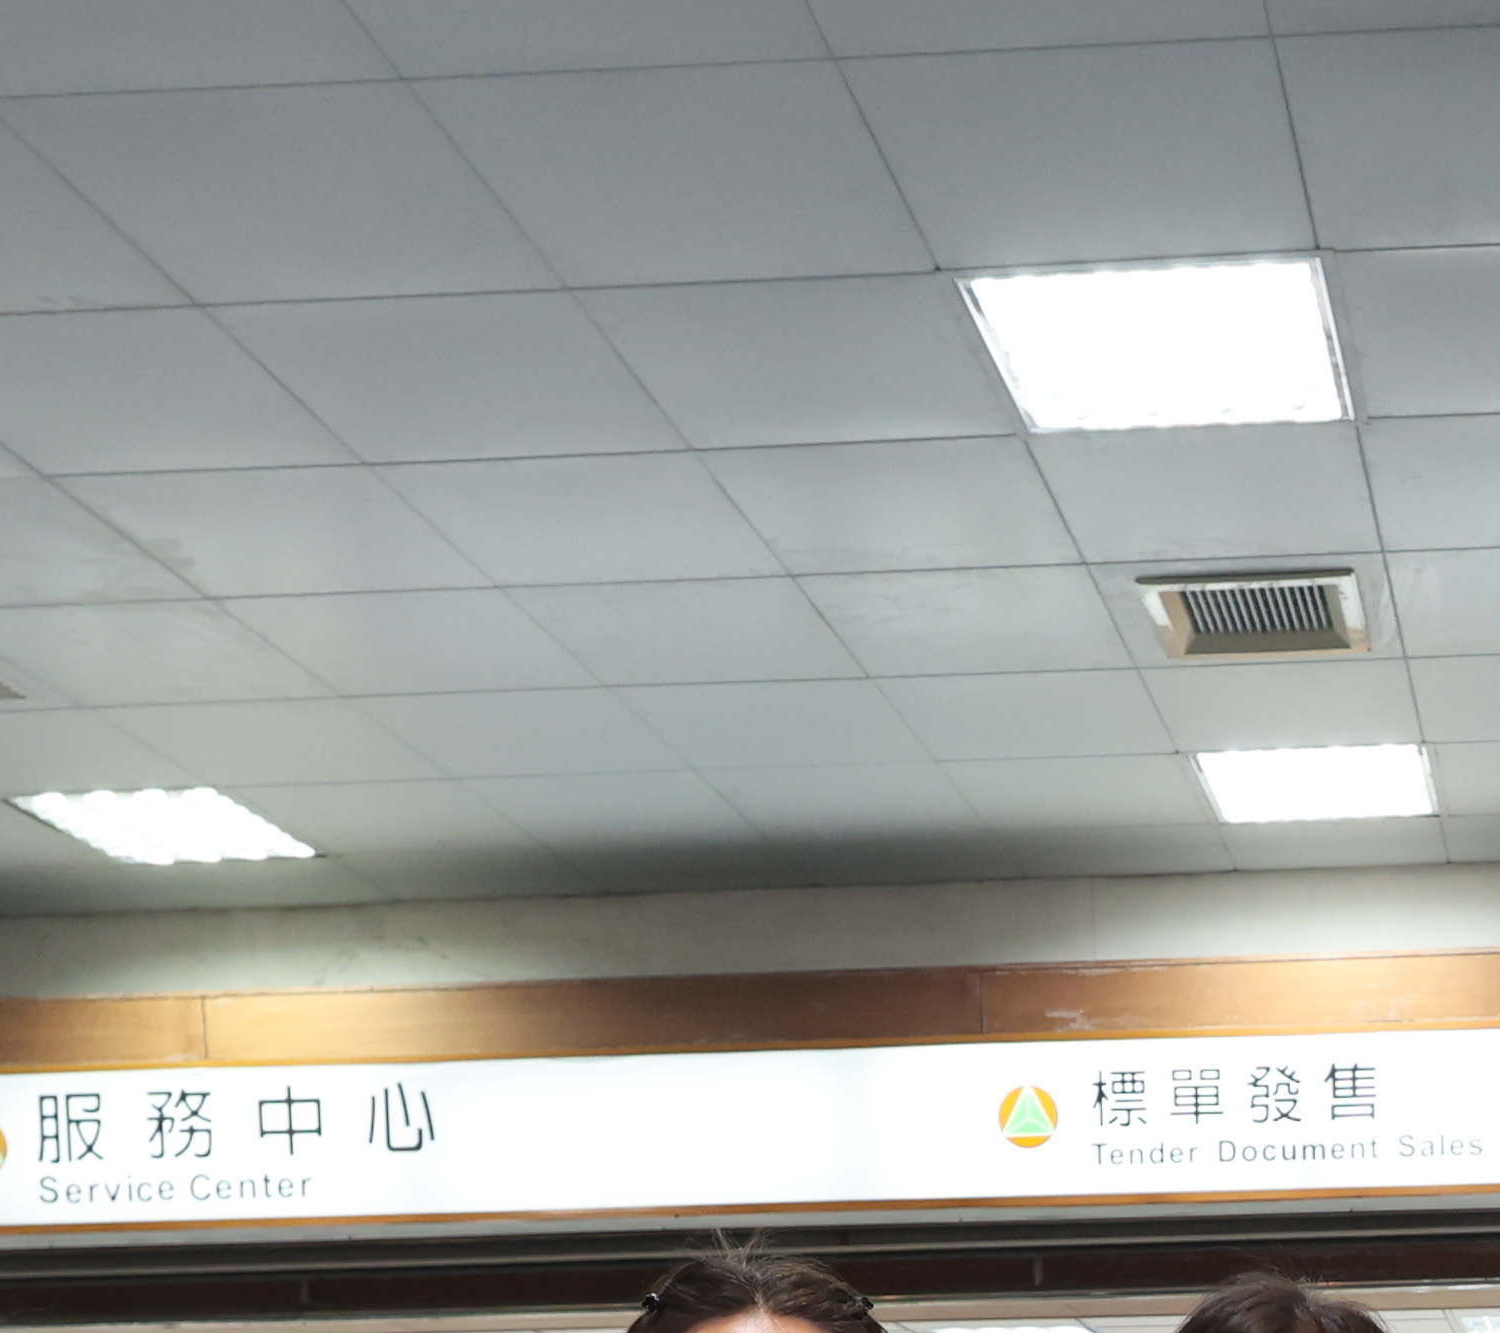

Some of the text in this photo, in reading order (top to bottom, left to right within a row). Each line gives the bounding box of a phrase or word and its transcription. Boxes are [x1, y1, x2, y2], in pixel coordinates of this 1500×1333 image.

[1092, 1061, 1380, 1128] 標單發售
[37, 1081, 436, 1165] 服務中心
[1091, 1132, 1485, 1167] Tender Document Sales
[38, 1170, 312, 1204] Service Center
